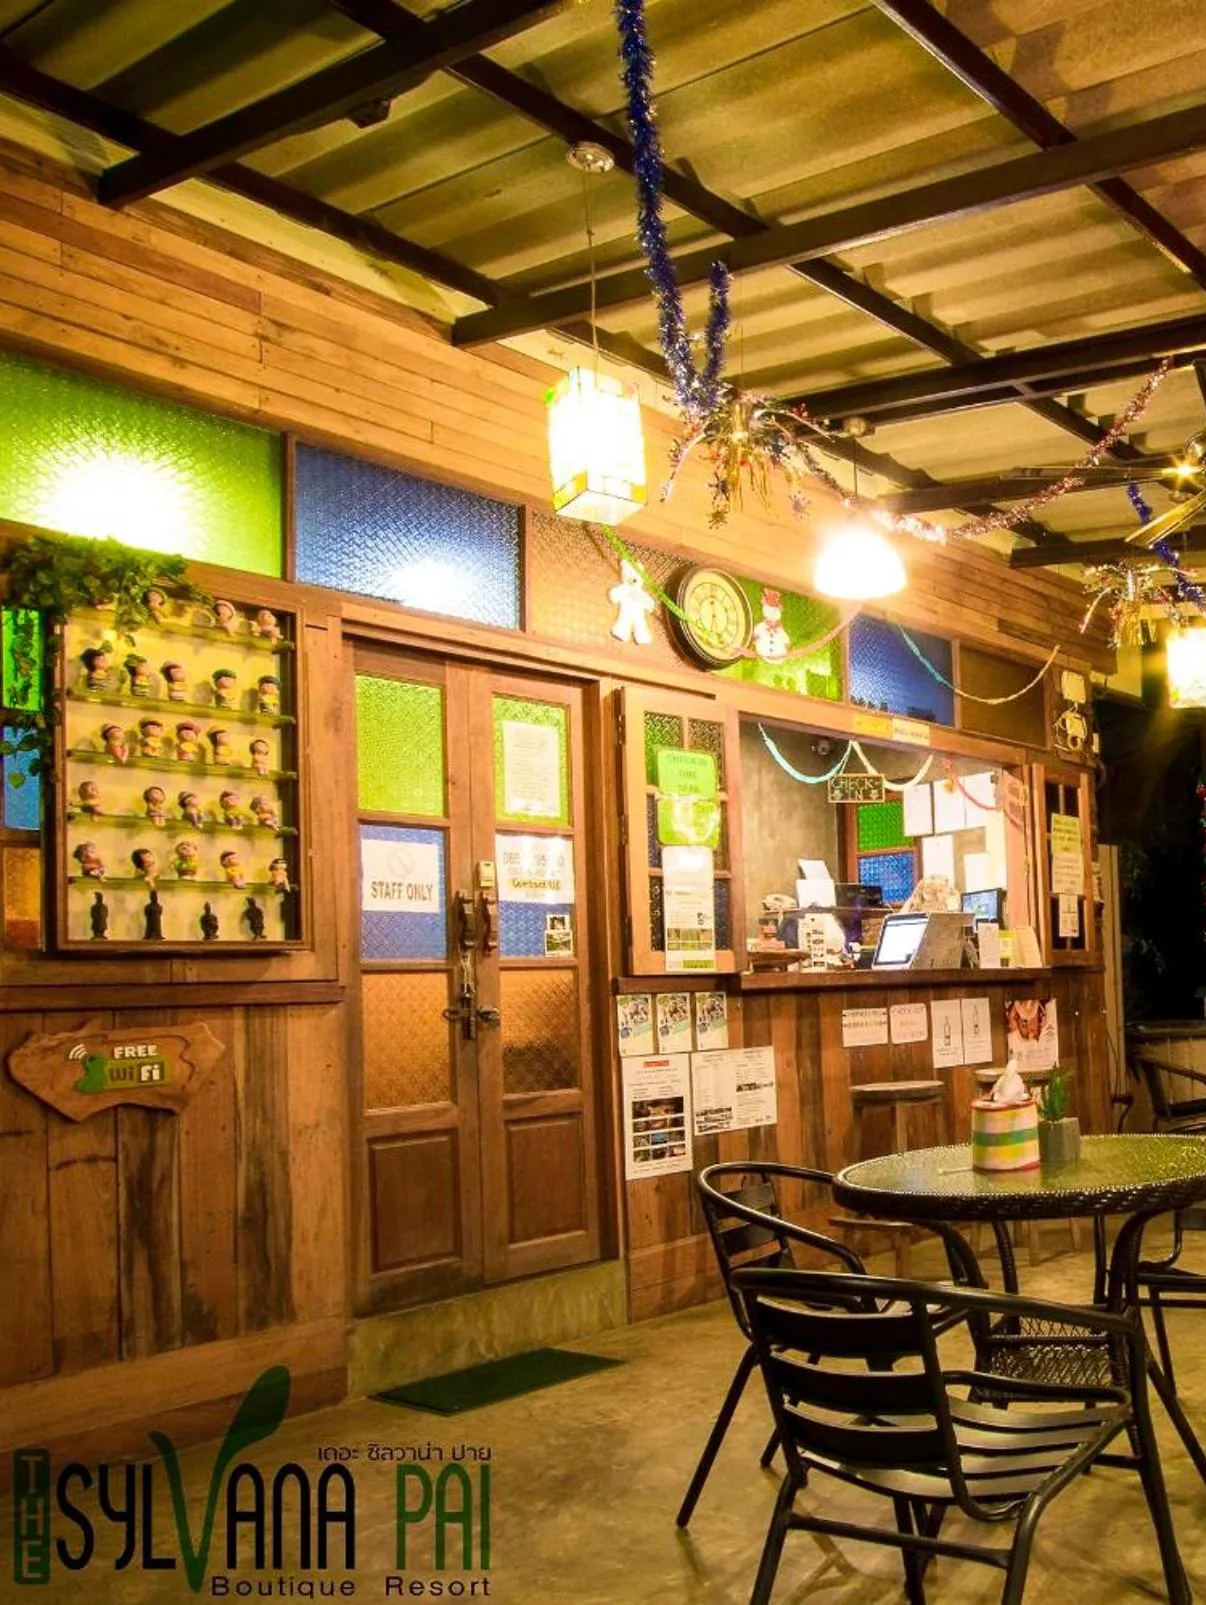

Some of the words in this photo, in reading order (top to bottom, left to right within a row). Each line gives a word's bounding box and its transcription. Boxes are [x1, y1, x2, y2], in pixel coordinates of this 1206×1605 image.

[370, 881, 403, 900] STAFF
[406, 883, 434, 901] ONLY
[113, 1044, 158, 1060] FREE
